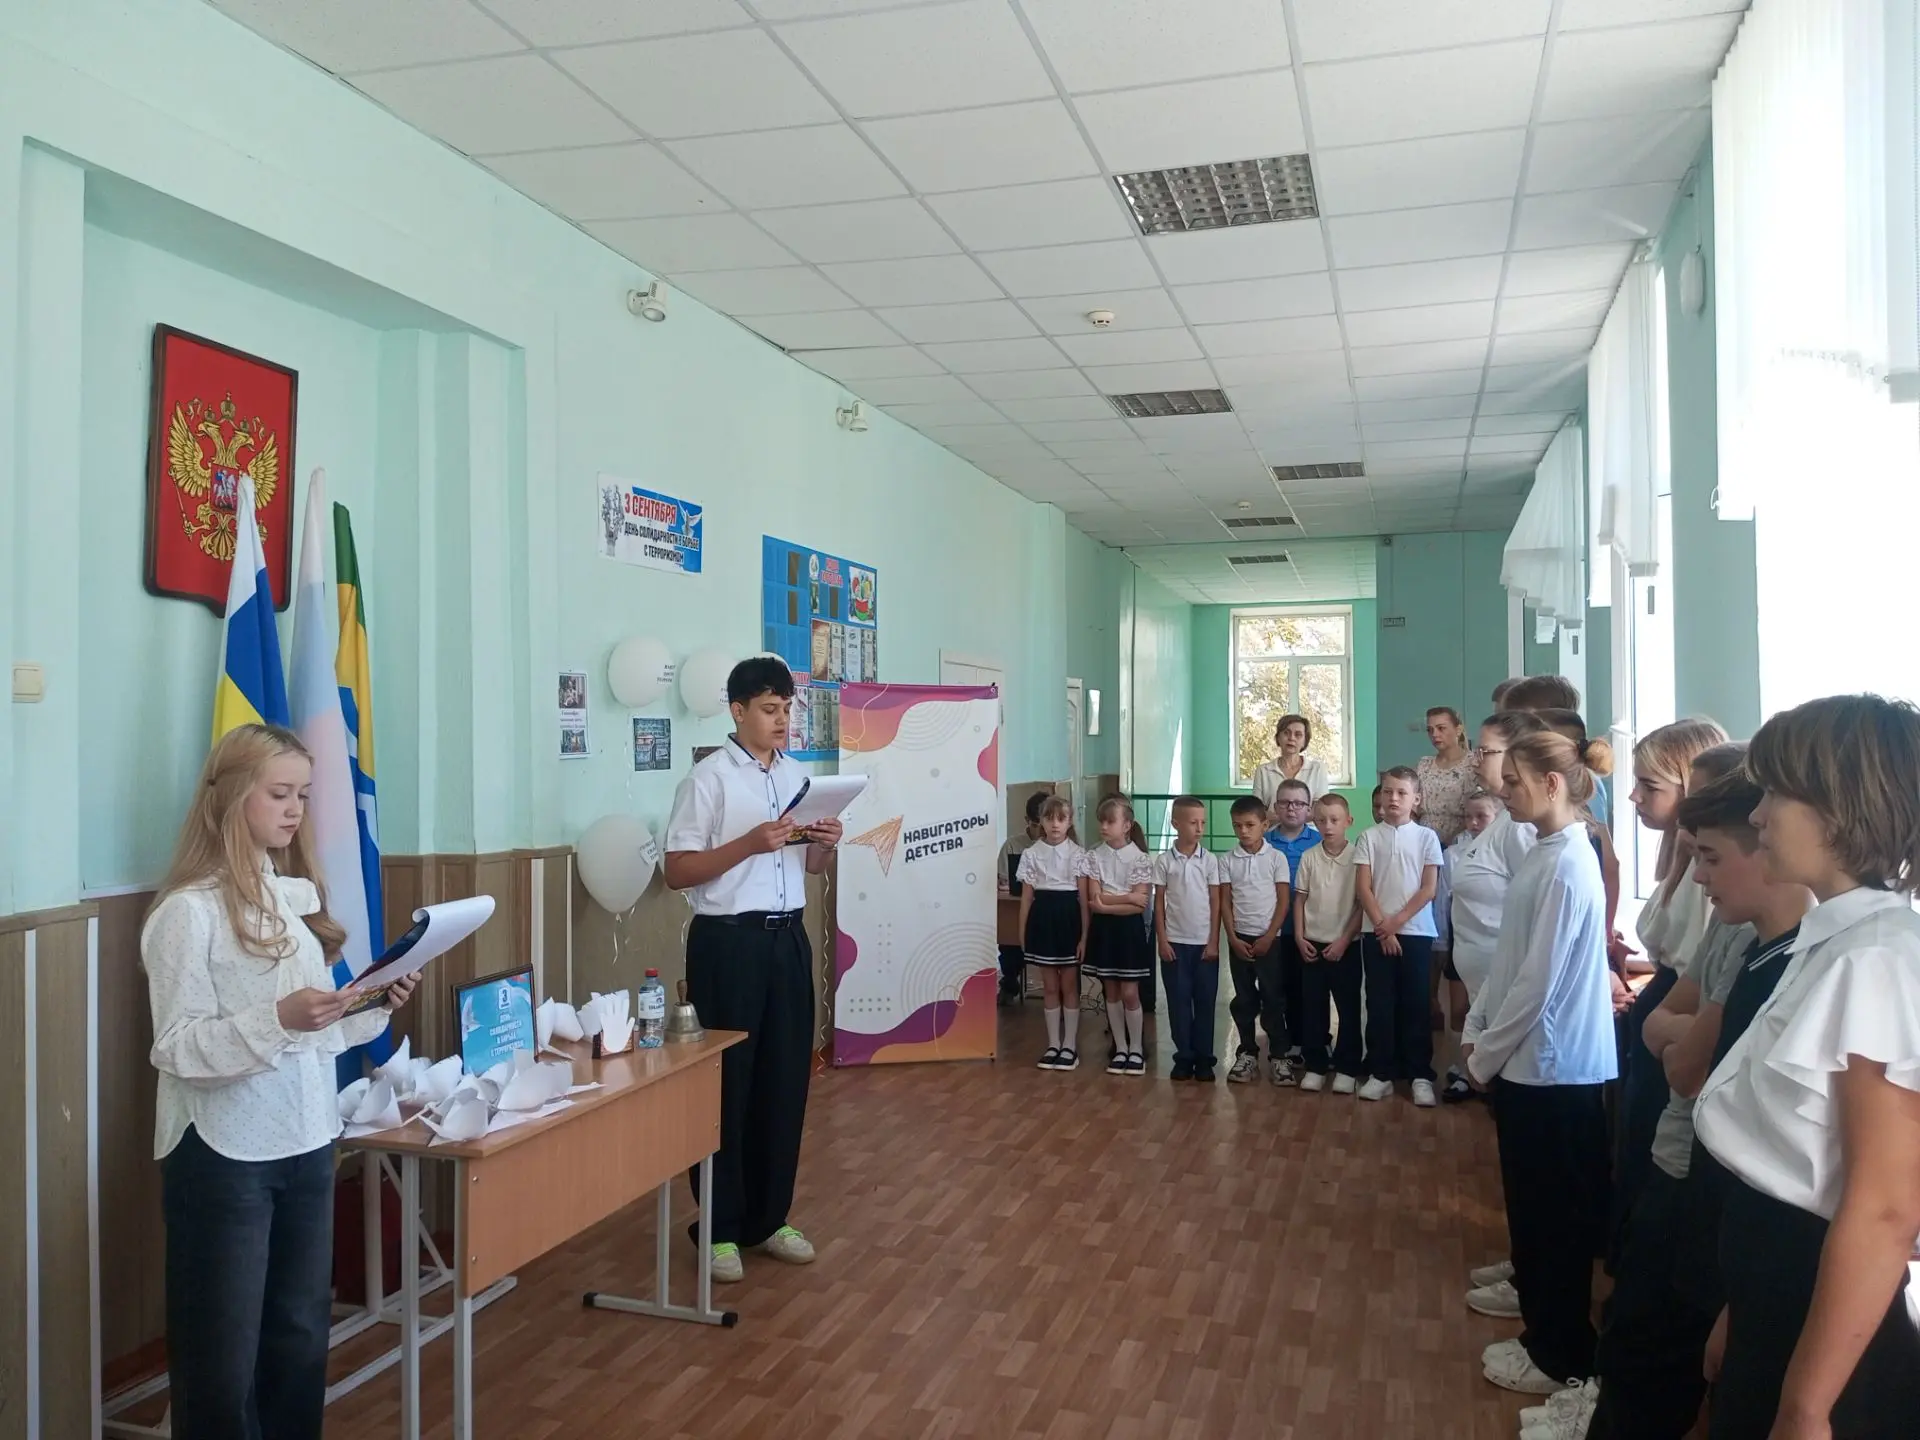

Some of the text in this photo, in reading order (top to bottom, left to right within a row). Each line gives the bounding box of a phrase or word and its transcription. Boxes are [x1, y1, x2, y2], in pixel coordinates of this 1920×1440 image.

[625, 493, 676, 525] 3 СЕНТЯБРЯ
[625, 522, 639, 536] ДЕНЬ
[904, 814, 989, 844] НАВИГАТОРЫ
[905, 836, 964, 863] ДЕТСТВА
[502, 989, 508, 1001] 3
